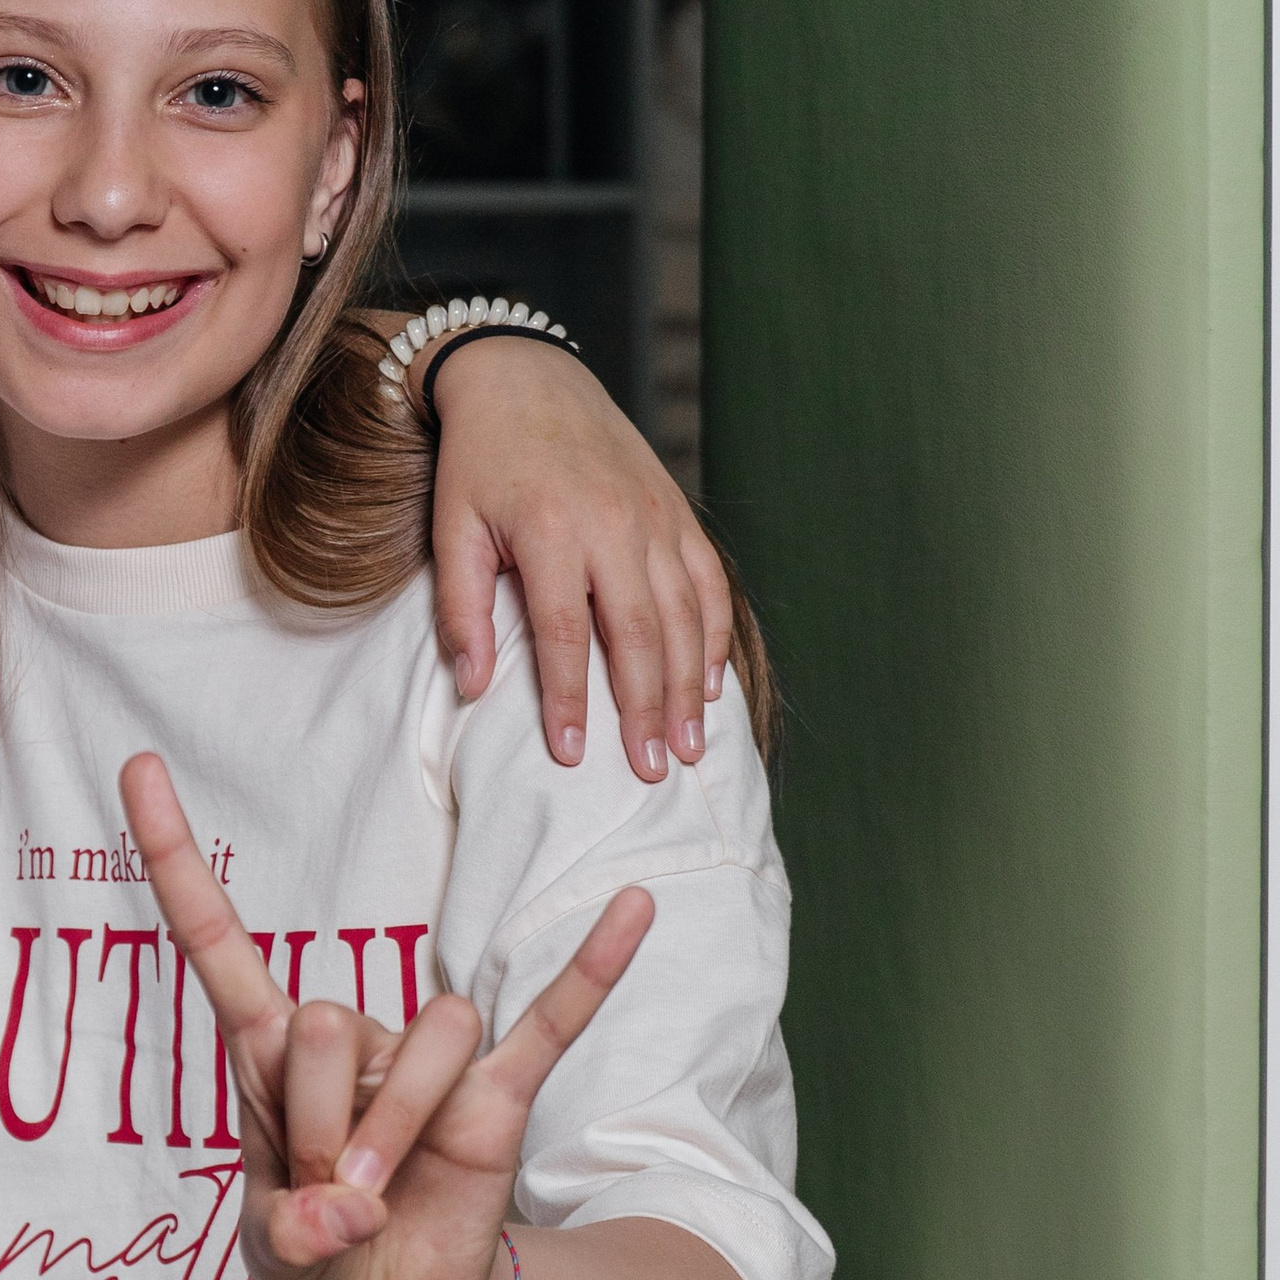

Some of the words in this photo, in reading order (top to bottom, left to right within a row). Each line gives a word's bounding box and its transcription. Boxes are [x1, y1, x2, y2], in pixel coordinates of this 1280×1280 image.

[16, 828, 56, 881] i'm
[69, 831, 152, 883] maki
[209, 837, 235, 885] it
